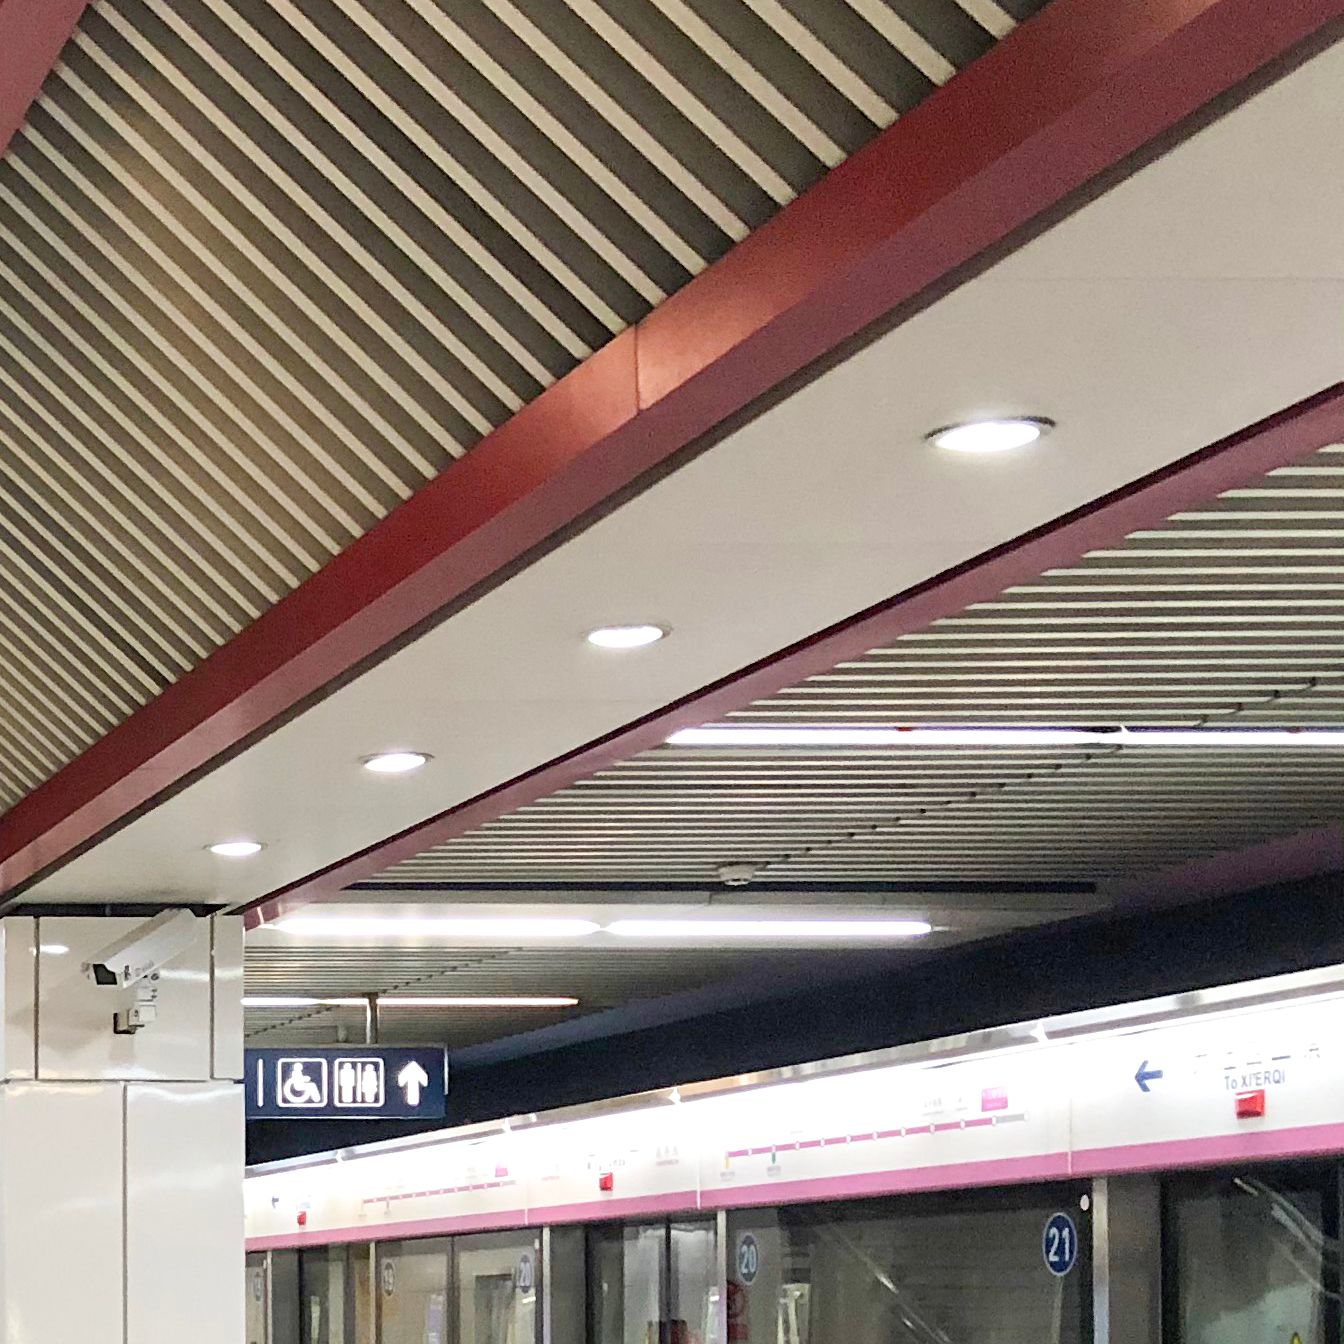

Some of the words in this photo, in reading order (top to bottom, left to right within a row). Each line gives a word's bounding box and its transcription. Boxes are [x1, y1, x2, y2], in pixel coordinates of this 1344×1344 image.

[1224, 1074, 1237, 1090] To
[740, 1244, 758, 1274] 20
[1049, 1227, 1070, 1261] 21
